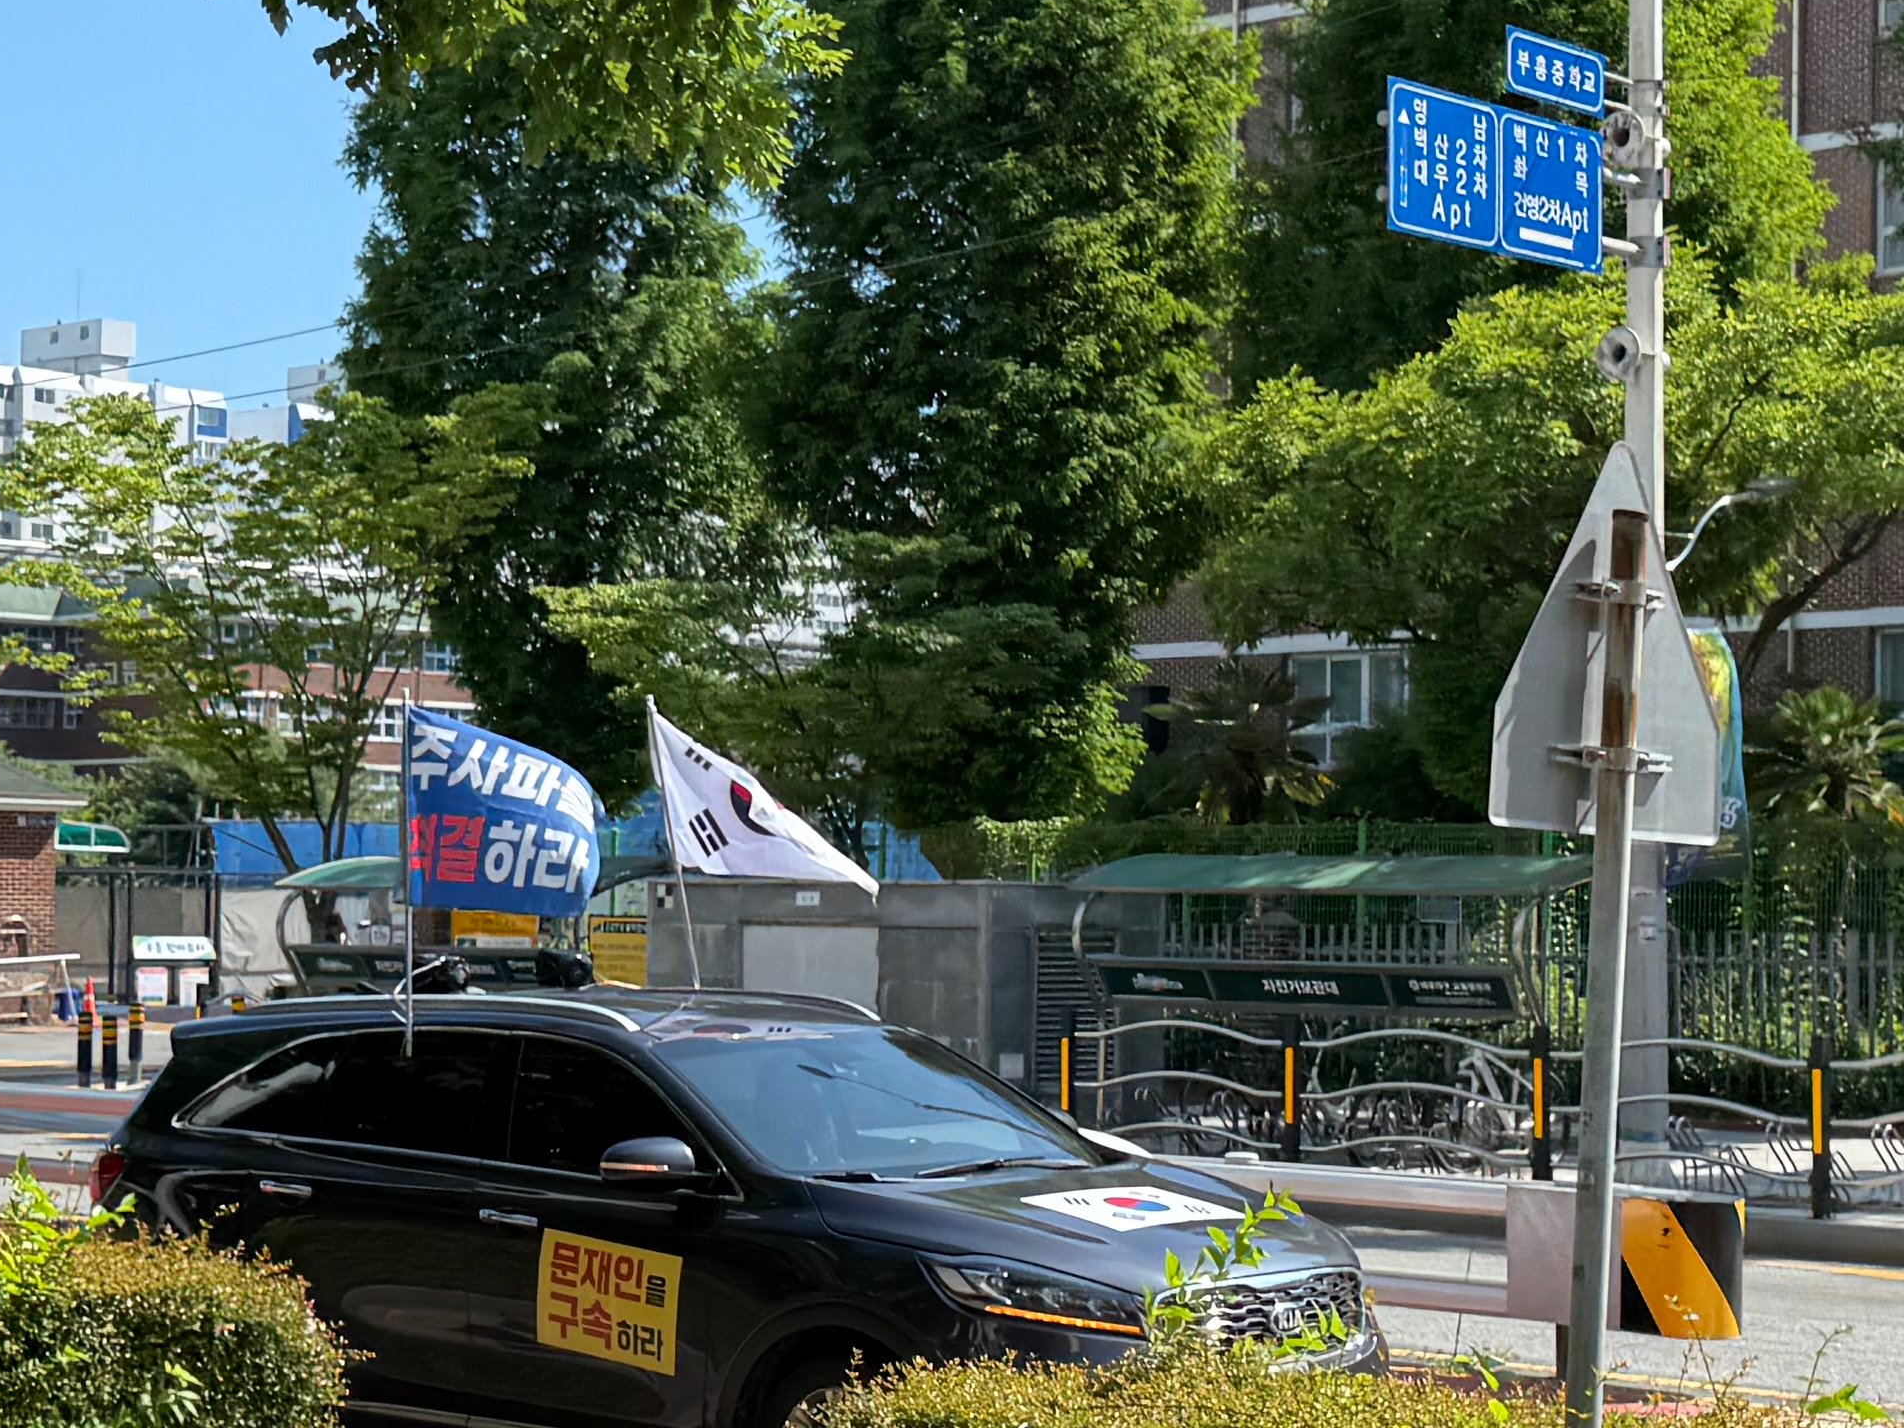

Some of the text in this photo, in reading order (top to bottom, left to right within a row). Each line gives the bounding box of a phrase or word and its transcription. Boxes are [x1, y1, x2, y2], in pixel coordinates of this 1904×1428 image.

[1516, 48, 1596, 93] 부흥중학교
[1432, 193, 1471, 230] Apt
[410, 724, 594, 835] 주사파를
[551, 1242, 666, 1308] 문재인을
[548, 1292, 664, 1361] 구속하라
